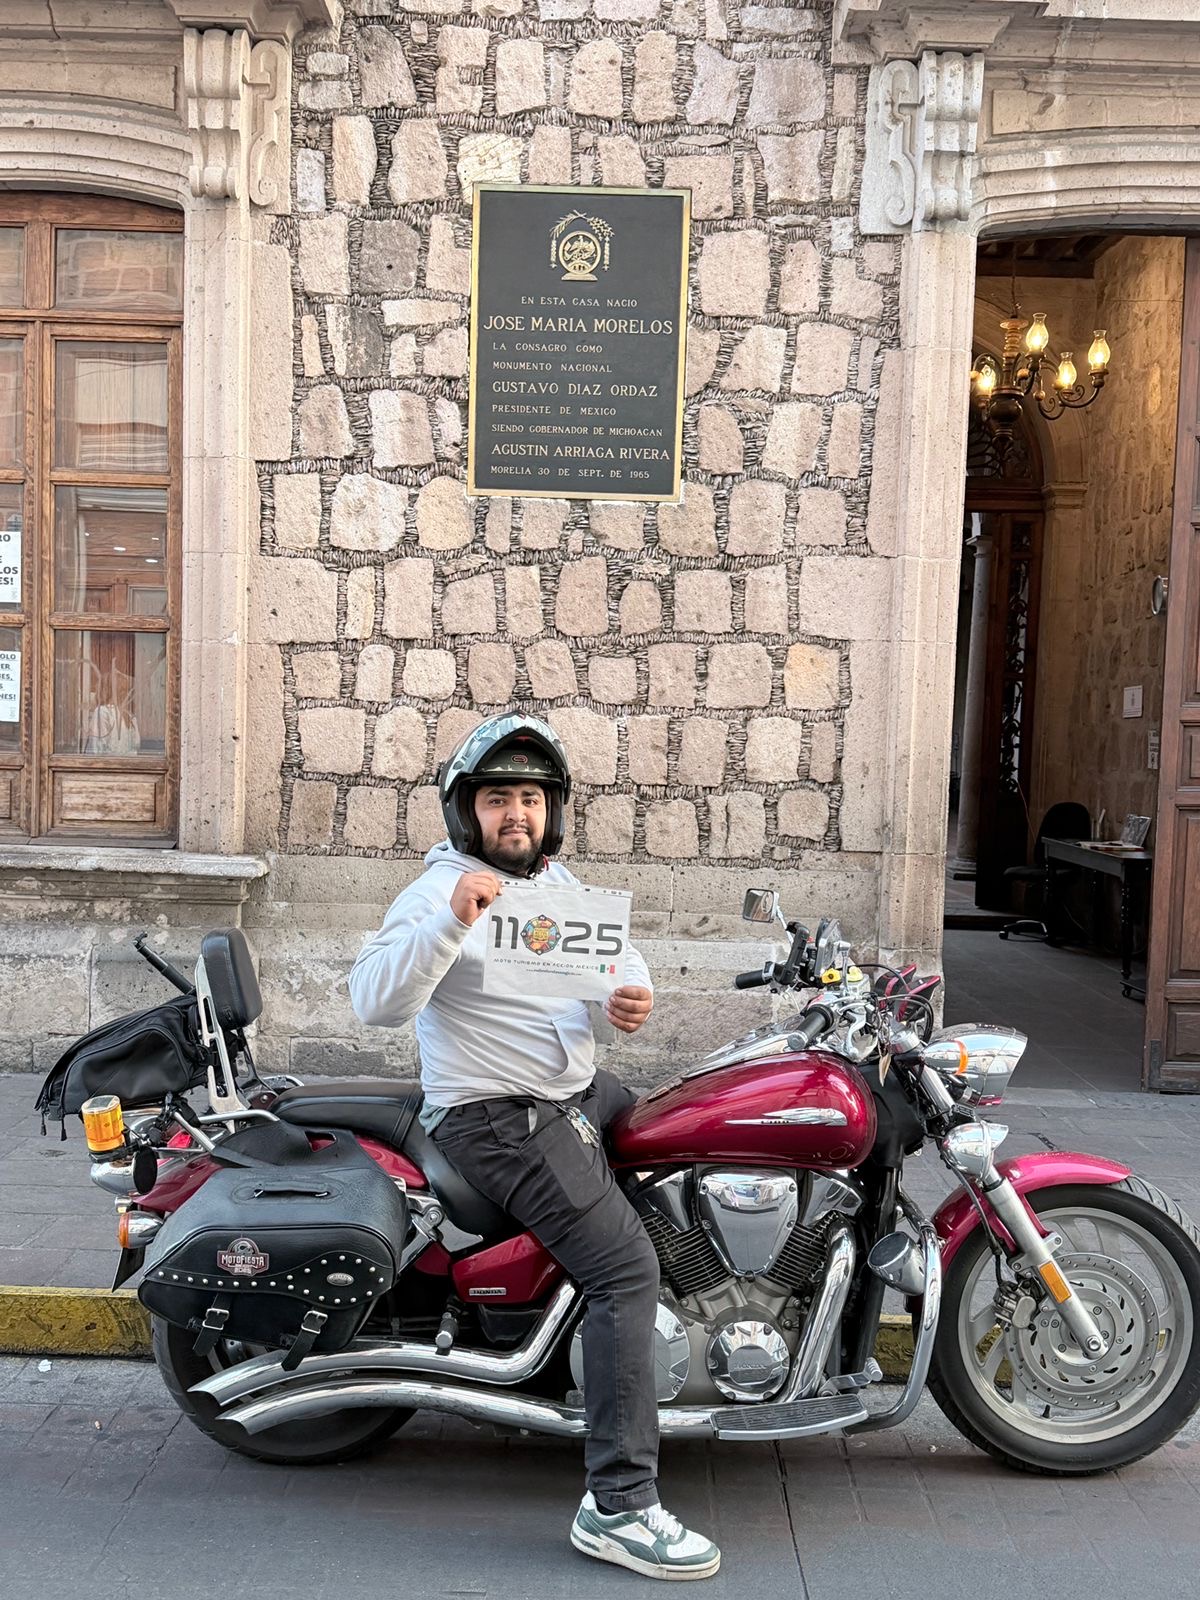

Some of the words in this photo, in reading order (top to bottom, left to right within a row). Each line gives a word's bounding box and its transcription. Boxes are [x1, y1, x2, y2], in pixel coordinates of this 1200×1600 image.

[522, 296, 534, 304] EN
[541, 297, 566, 305] ESTA
[572, 298, 600, 306] CASA
[607, 299, 637, 307] NACIO
[484, 316, 525, 330] JOSE
[531, 317, 587, 332] MARIA
[593, 319, 673, 335] MORELOS
[493, 342, 506, 350] LA
[516, 343, 567, 352] CONSAGRO
[576, 345, 602, 353] COMO
[493, 361, 552, 371] MONUMENTO
[561, 363, 612, 373] NACIONAL
[493, 381, 558, 394] GUSTAVO
[568, 383, 601, 395] DIAZ
[610, 385, 657, 397] ORDAZ
[492, 405, 551, 414] PRESIDENTE
[580, 407, 616, 415] MEXICO
[492, 424, 524, 432] SIENDO
[529, 425, 588, 435] GOBERNADOR
[593, 427, 604, 435] DE
[609, 428, 662, 436] MICHOACAN
[492, 444, 548, 456] AGUSTIN
[554, 446, 614, 458] ARRIAGA
[620, 448, 670, 460] RIVERA
[491, 466, 531, 474] MORELIA
[558, 468, 570, 476] DE
[579, 469, 604, 477] SEPT.
[610, 470, 621, 478] DE
